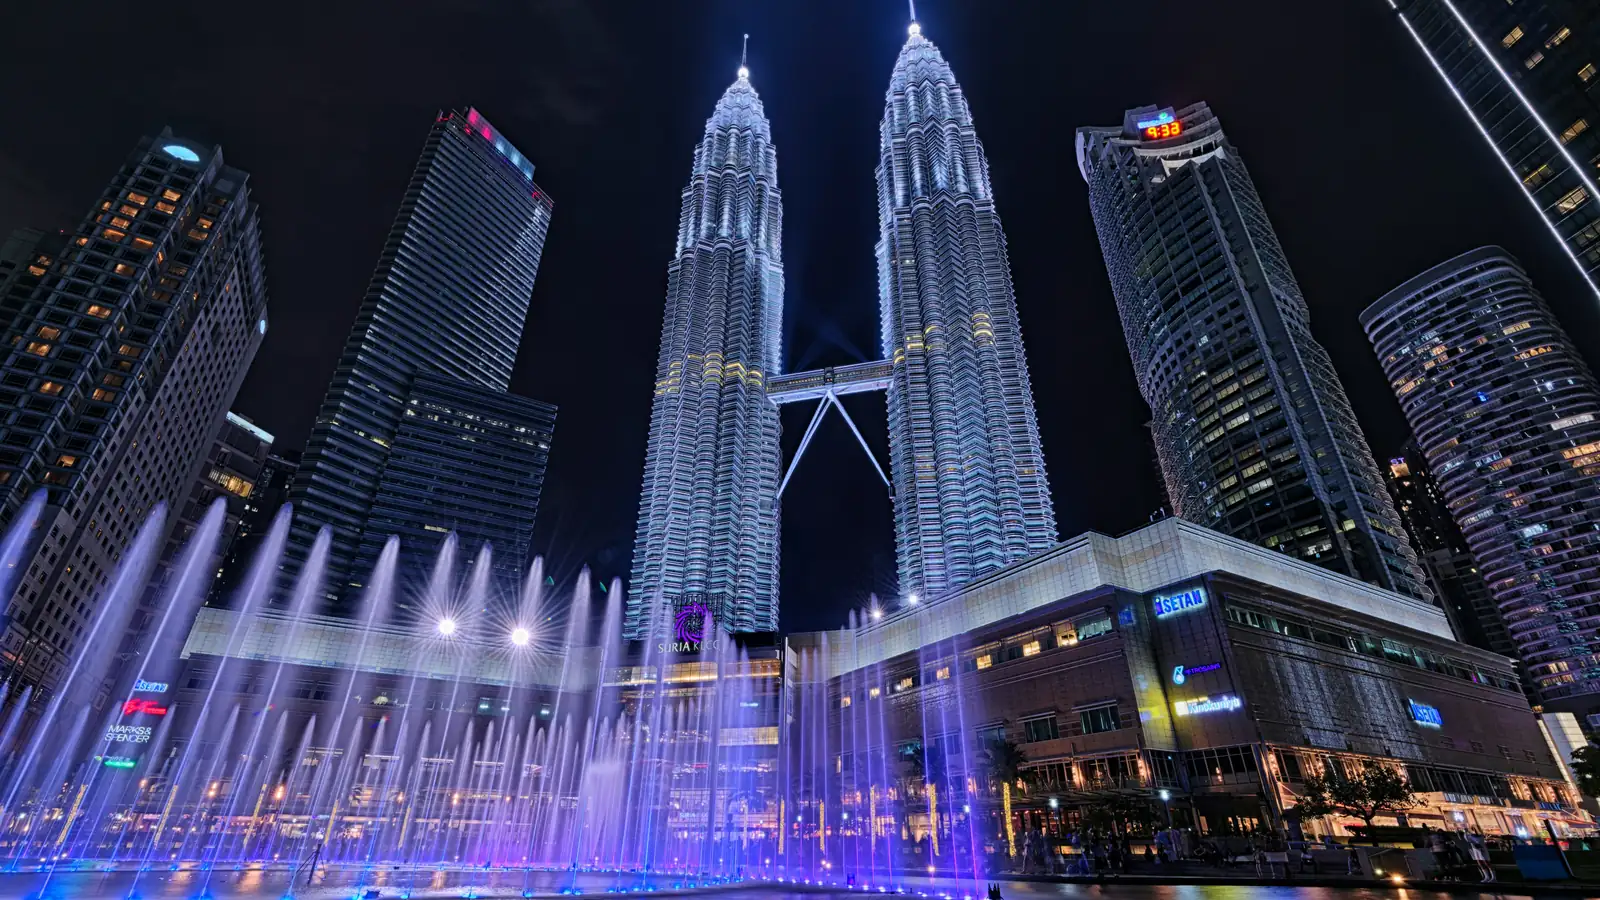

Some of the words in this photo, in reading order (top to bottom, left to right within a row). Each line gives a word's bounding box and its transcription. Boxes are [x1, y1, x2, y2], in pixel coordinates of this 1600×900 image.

[1147, 121, 1180, 138] 9:33
[658, 641, 690, 653] SURIA
[104, 733, 150, 743] SPENCER
